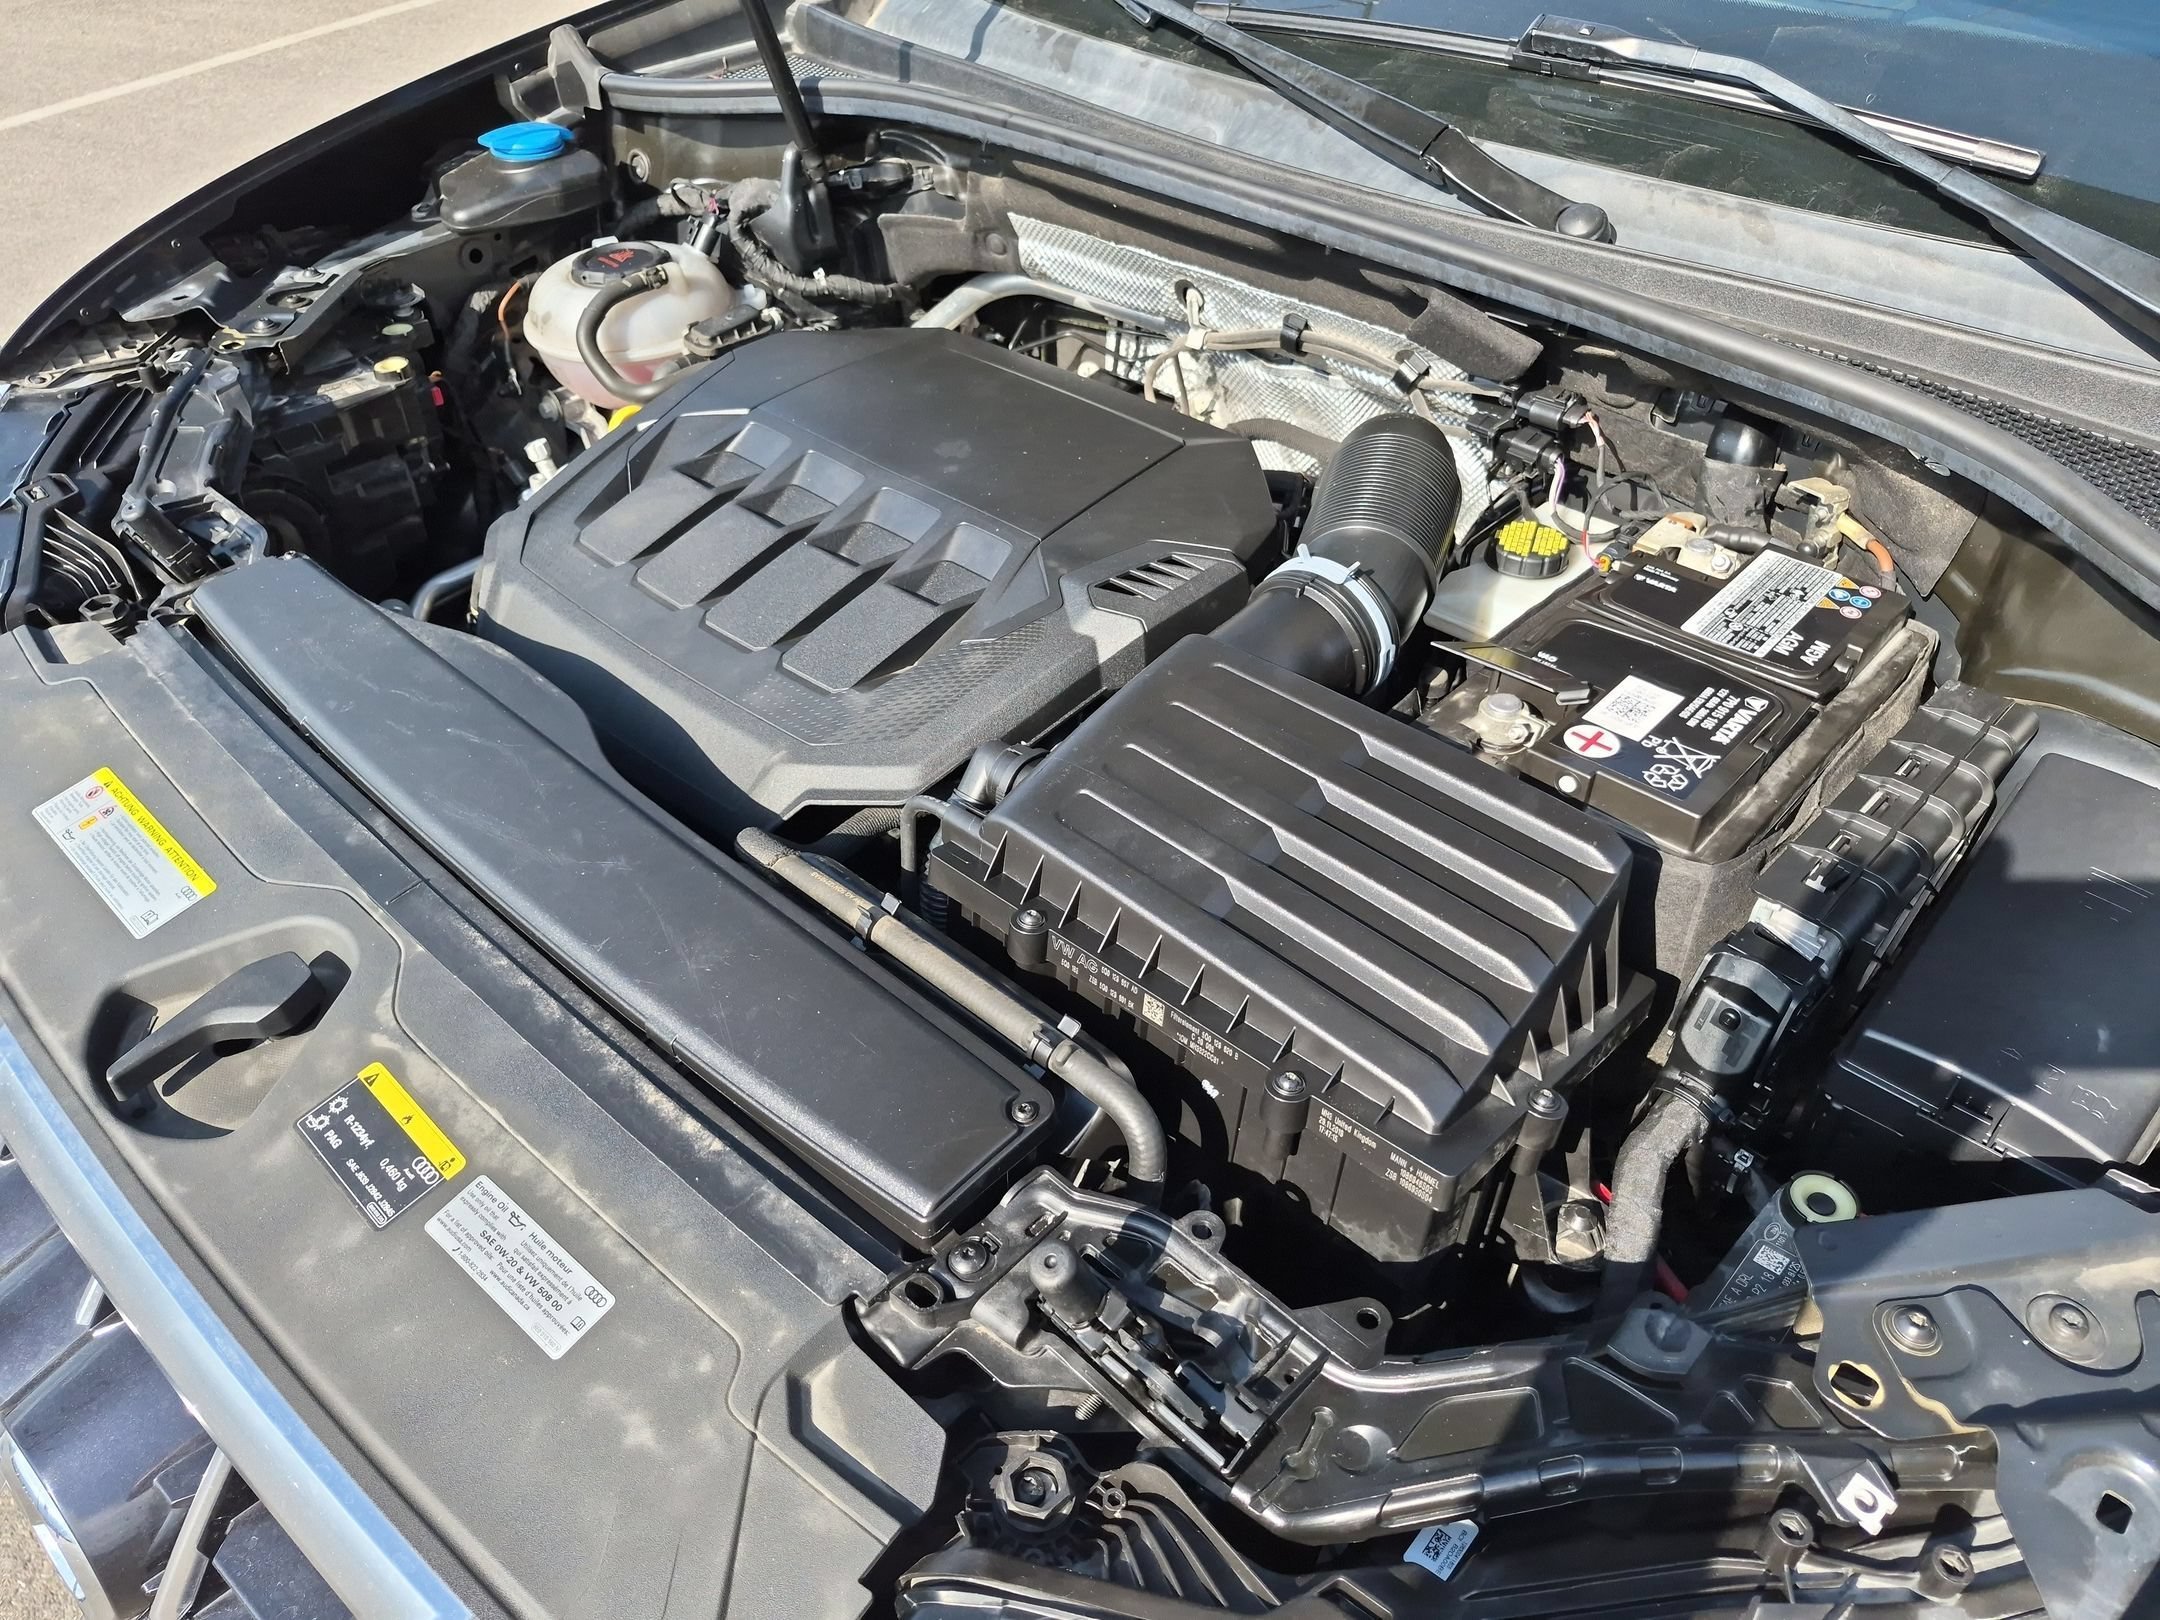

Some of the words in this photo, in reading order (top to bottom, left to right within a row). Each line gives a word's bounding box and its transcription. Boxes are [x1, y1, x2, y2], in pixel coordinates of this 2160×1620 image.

[1772, 630, 1803, 655] AGM
[1799, 640, 1830, 666] AGM
[1710, 705, 1730, 719] 915
[1720, 694, 1742, 708] 7P0
[1699, 716, 1719, 730] 105
[1709, 708, 1757, 745] VARTA
[1641, 734, 1662, 747] Pb
[109, 787, 138, 816] ACHTUNG
[135, 815, 167, 846] WARNING
[163, 845, 200, 882] ATTENTION
[1052, 935, 1075, 958] VW
[1077, 954, 1098, 973] AG
[323, 1129, 343, 1149] PAG
[1335, 1117, 1352, 1133] United
[1353, 1129, 1377, 1149] Kingdom
[345, 1157, 359, 1172] SAE
[377, 1156, 401, 1182] 0,460
[393, 1176, 410, 1192] kg
[1390, 1152, 1407, 1168] MANN
[1416, 1169, 1439, 1189] HUMMEL
[466, 1189, 477, 1199] Use
[473, 1196, 485, 1207] only
[488, 1210, 500, 1220] that
[473, 1180, 499, 1204] Engine
[496, 1200, 509, 1213] Oil
[442, 1209, 453, 1219] For
[453, 1219, 462, 1228] list
[458, 1195, 479, 1215] expressly
[477, 1213, 497, 1232] complies
[495, 1230, 507, 1241] with
[460, 1225, 468, 1233] of
[463, 1230, 486, 1252] approved
[519, 1240, 538, 1257] Utilisez
[534, 1255, 563, 1282] uniquement
[560, 1279, 569, 1288] de
[527, 1231, 548, 1250] Huile
[545, 1248, 573, 1275] moteur
[478, 1229, 496, 1246] SAE
[493, 1243, 518, 1268] 0W-20
[515, 1265, 525, 1275] &
[523, 1272, 539, 1288] VW
[536, 1285, 553, 1302] 508
[550, 1299, 563, 1312] 00
[495, 1261, 509, 1274] Pour
[506, 1272, 516, 1283] une
[514, 1280, 527, 1292] liste
[511, 1247, 522, 1257] qui
[520, 1254, 539, 1272] satisfait
[535, 1270, 569, 1302] expressément
[1736, 1272, 1754, 1287] DRL
[1760, 1271, 1774, 1282] 18
[488, 1269, 531, 1311] www.audicanada.ca
[1731, 1287, 1742, 1295] A
